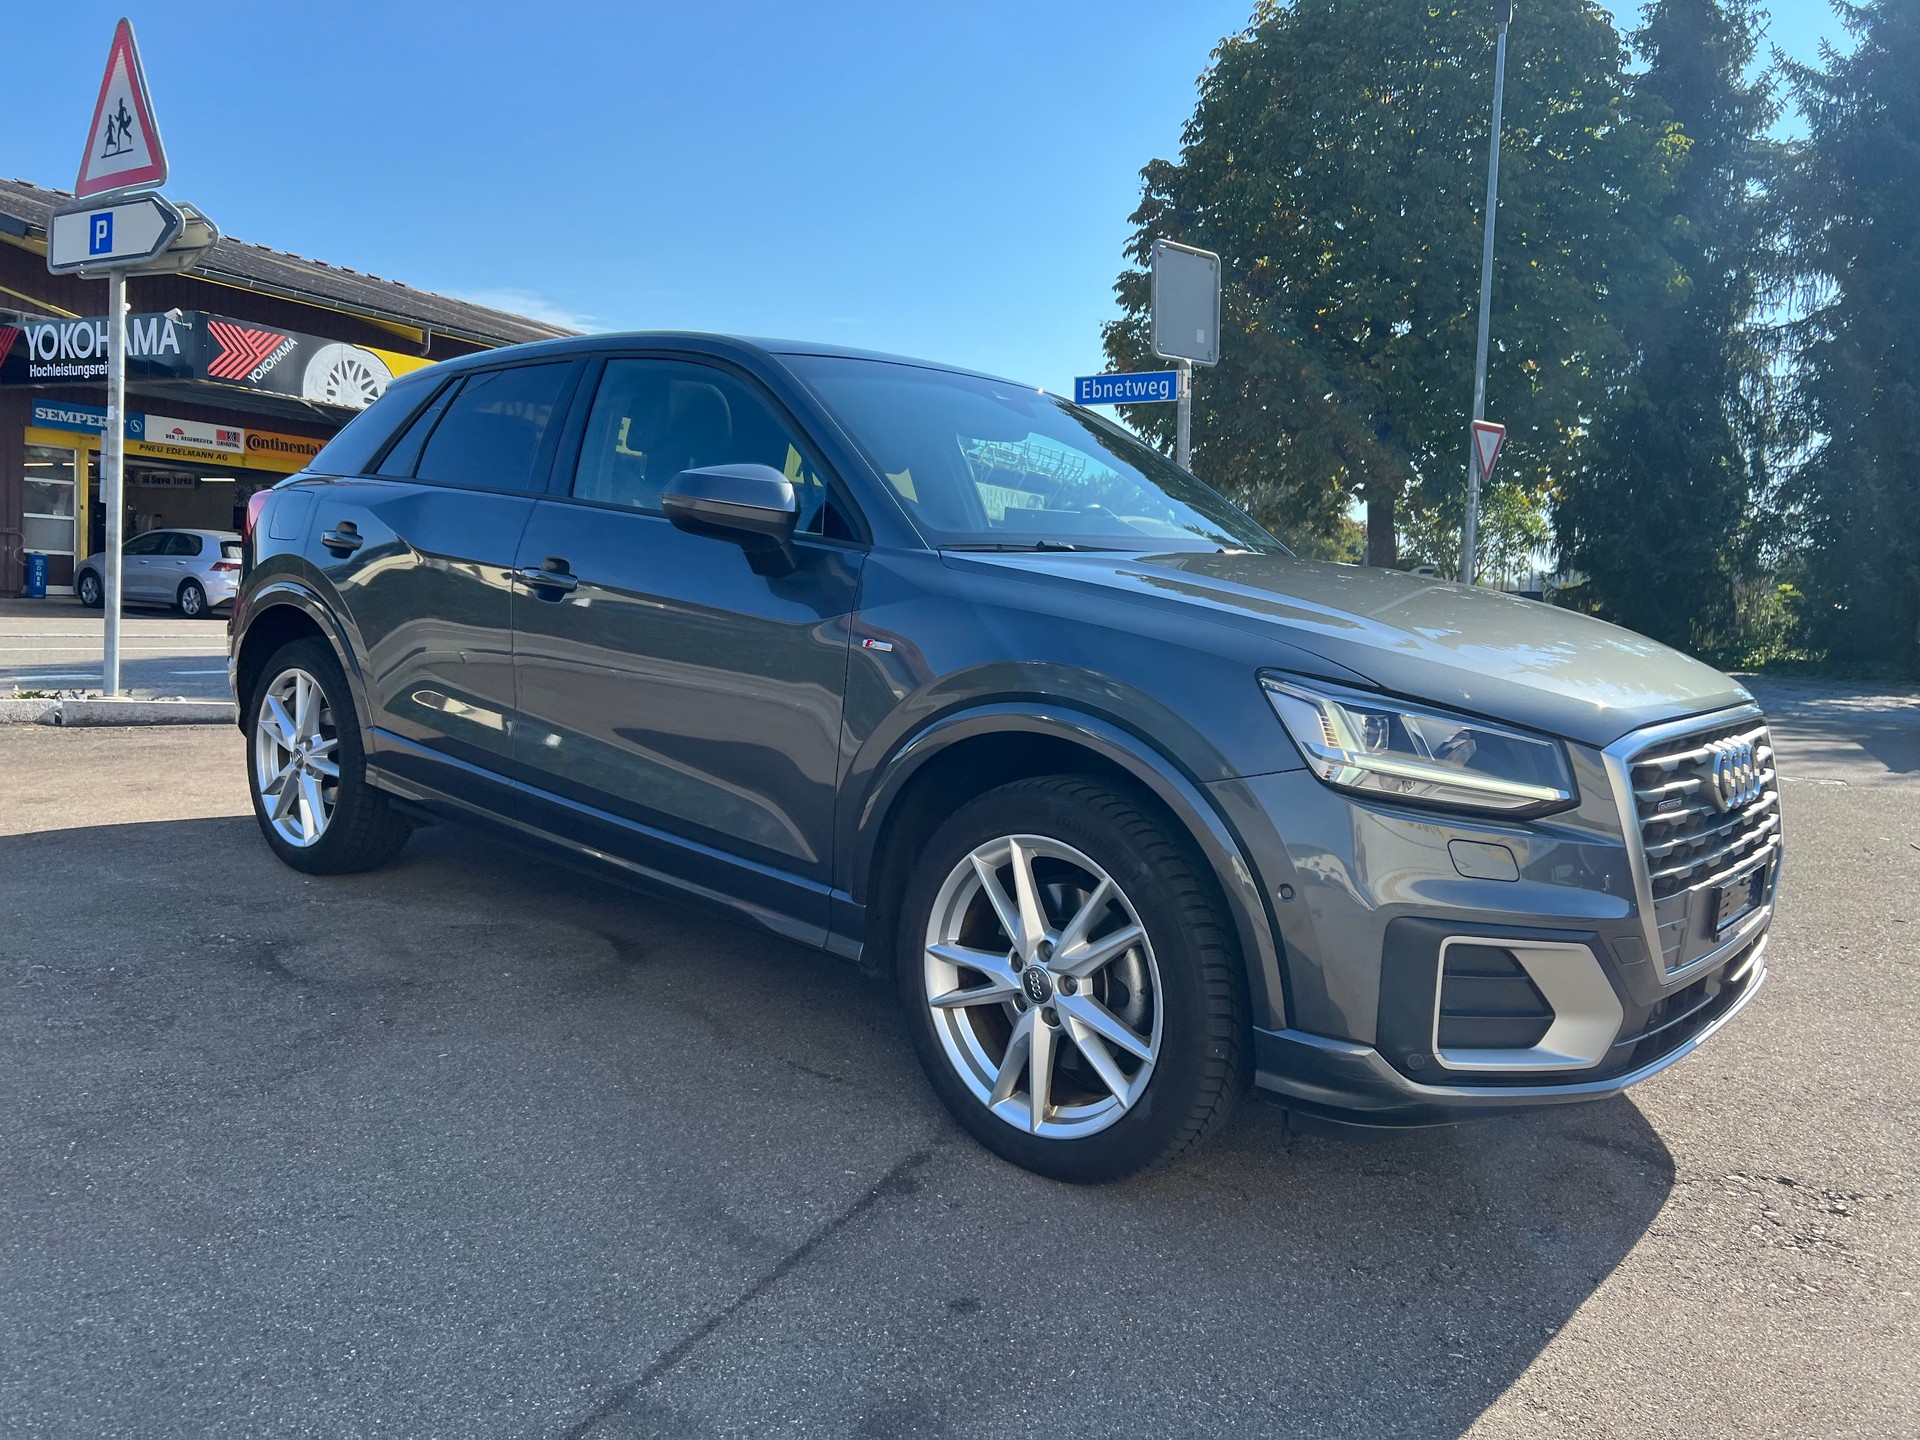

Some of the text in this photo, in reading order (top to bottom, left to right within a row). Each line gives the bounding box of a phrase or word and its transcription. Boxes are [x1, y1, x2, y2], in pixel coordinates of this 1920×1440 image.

[95, 219, 108, 250] P
[29, 360, 109, 379] Hochleistungsrei
[247, 337, 299, 384] YOKOHAMA
[1082, 379, 1169, 400] Ebnetweg
[35, 407, 127, 428] SEMPER
[139, 444, 228, 461] PNEU EDELMANN AG
[979, 486, 1018, 508] OHAMA
